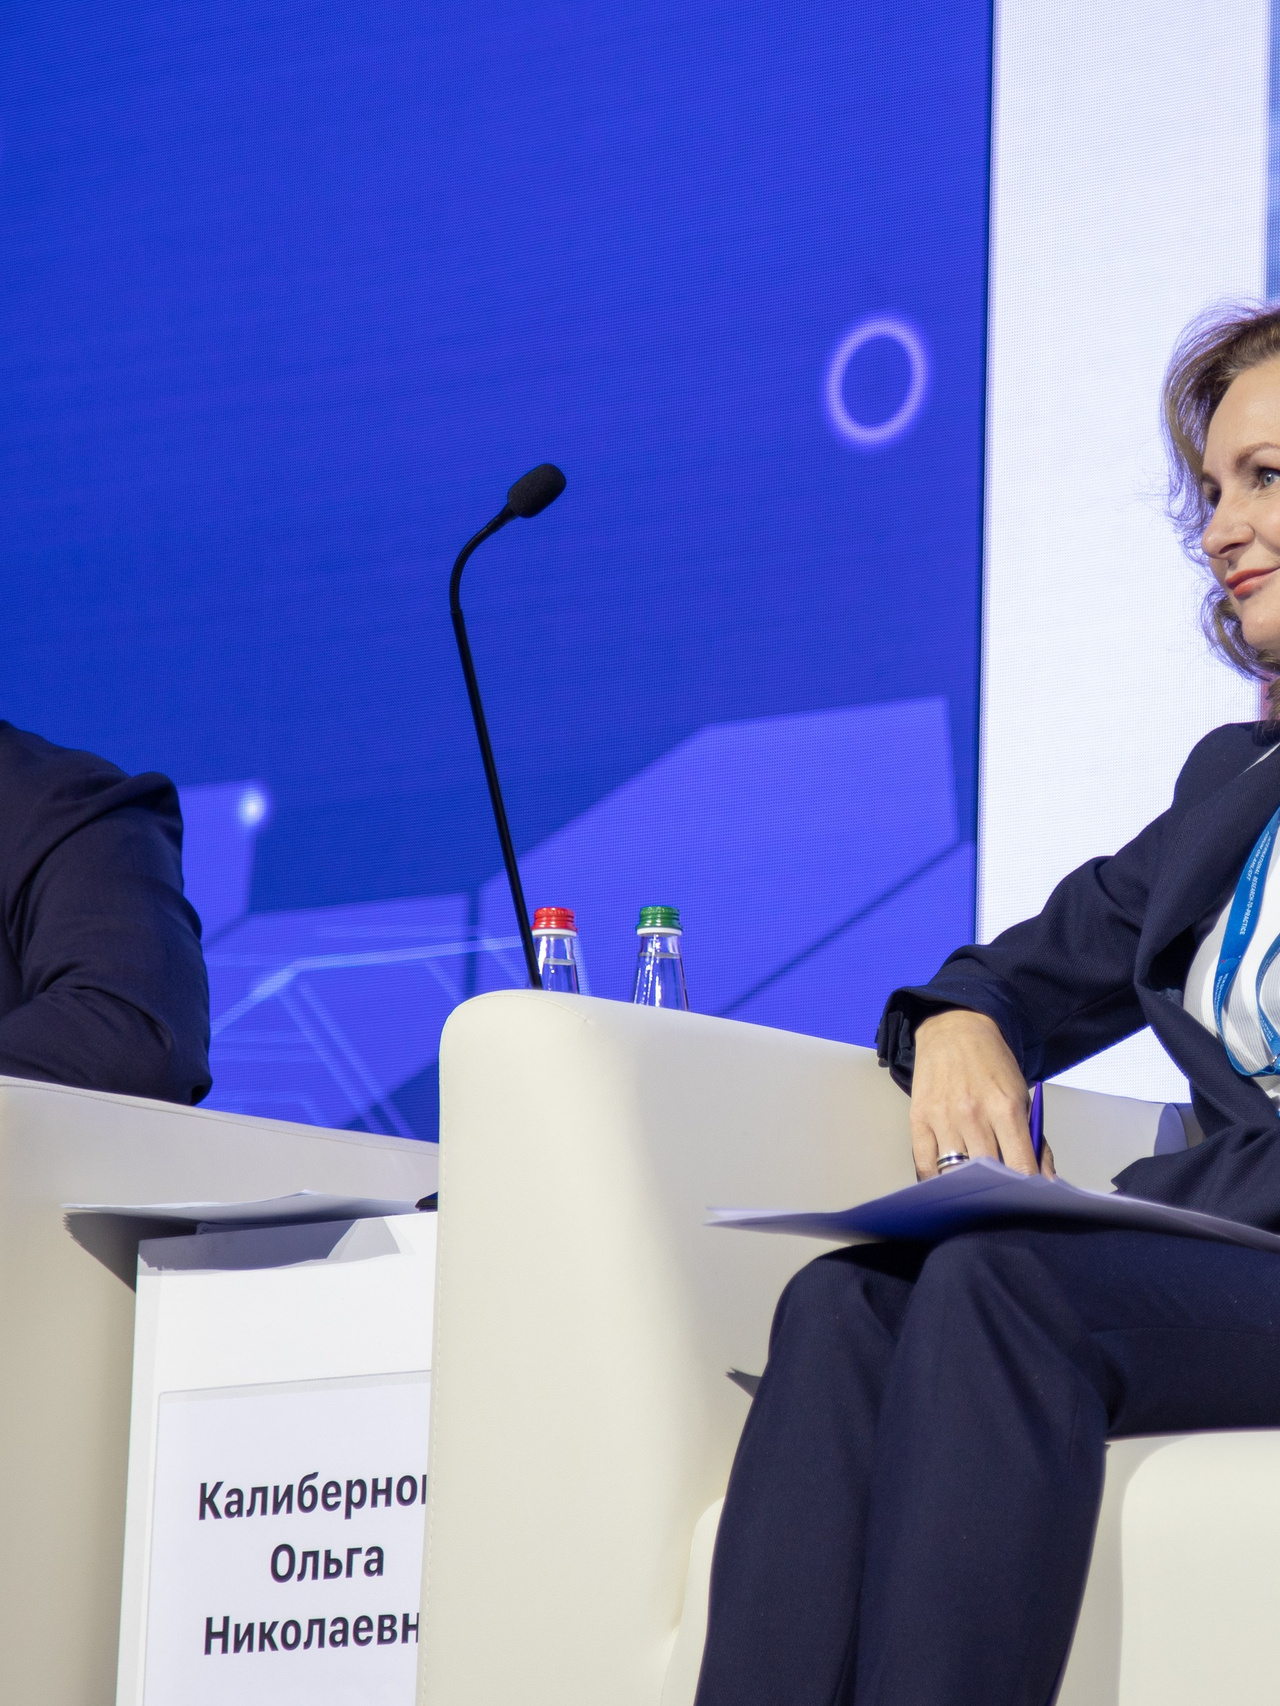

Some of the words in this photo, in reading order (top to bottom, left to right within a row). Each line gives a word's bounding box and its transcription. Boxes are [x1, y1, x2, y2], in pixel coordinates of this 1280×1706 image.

[1254, 835, 1272, 876] INTERNATIONAL
[1239, 875, 1259, 935] RESEARCH-TO-PRACTICE
[198, 1472, 428, 1521] Калиберно
[270, 1543, 385, 1583] Ольга
[204, 1612, 420, 1656] Николаевн
